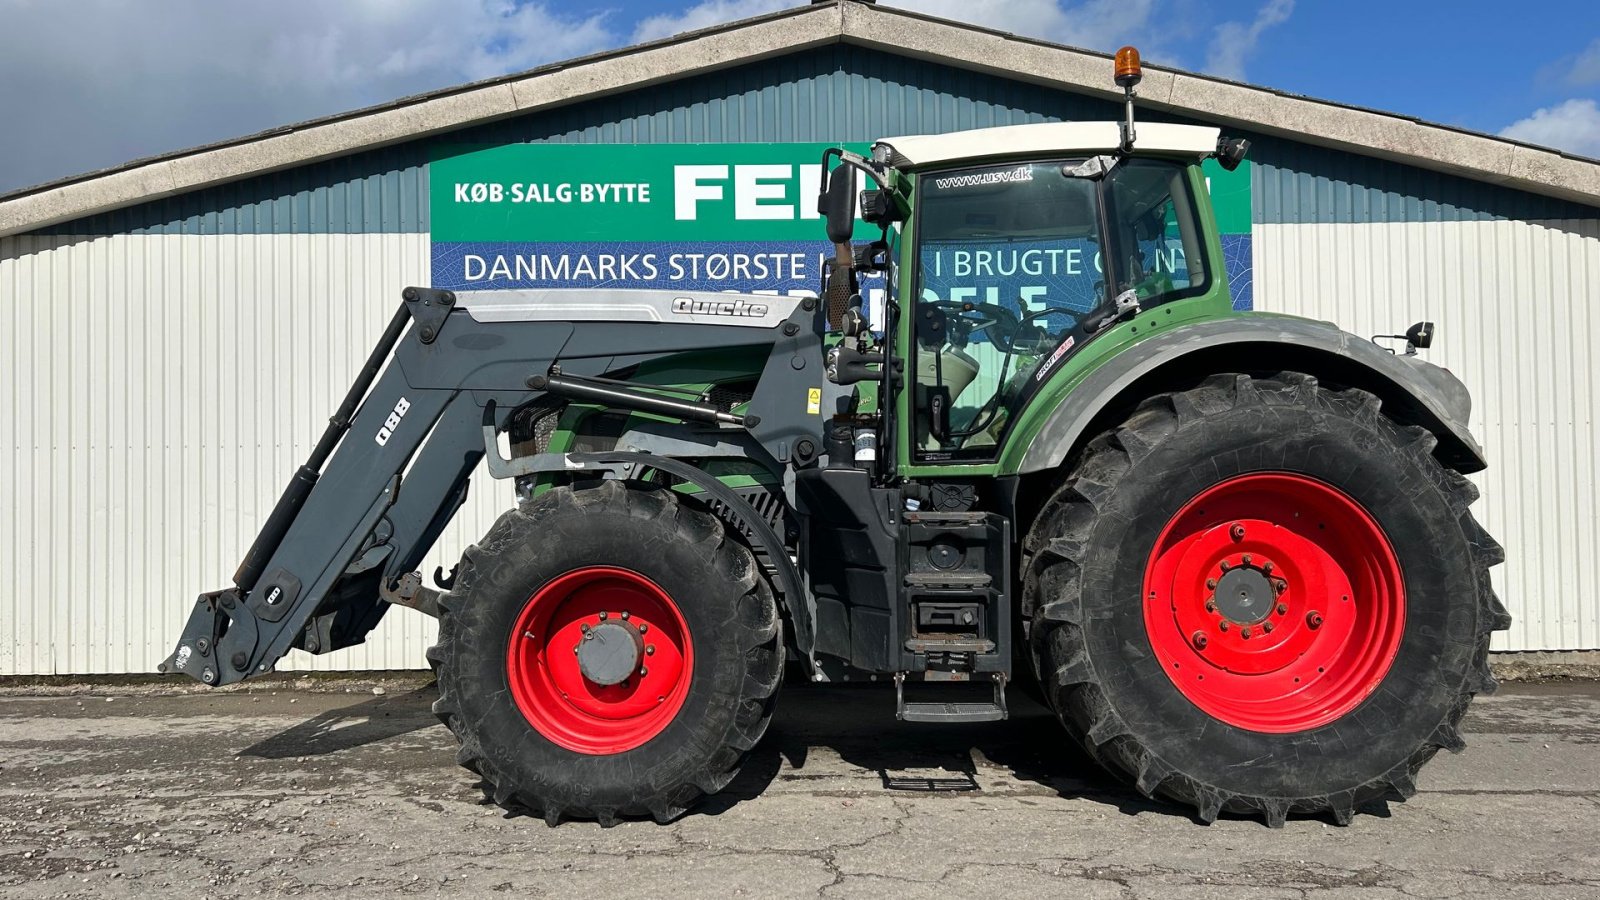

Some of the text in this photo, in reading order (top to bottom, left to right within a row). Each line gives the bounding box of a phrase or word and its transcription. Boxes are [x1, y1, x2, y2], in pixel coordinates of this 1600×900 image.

[936, 167, 1033, 189] www.usv.dk
[464, 253, 659, 281] DANMARKS
[669, 253, 806, 280] STØRSTE
[954, 249, 1082, 277] BRUGTE
[671, 297, 768, 318] Quicke
